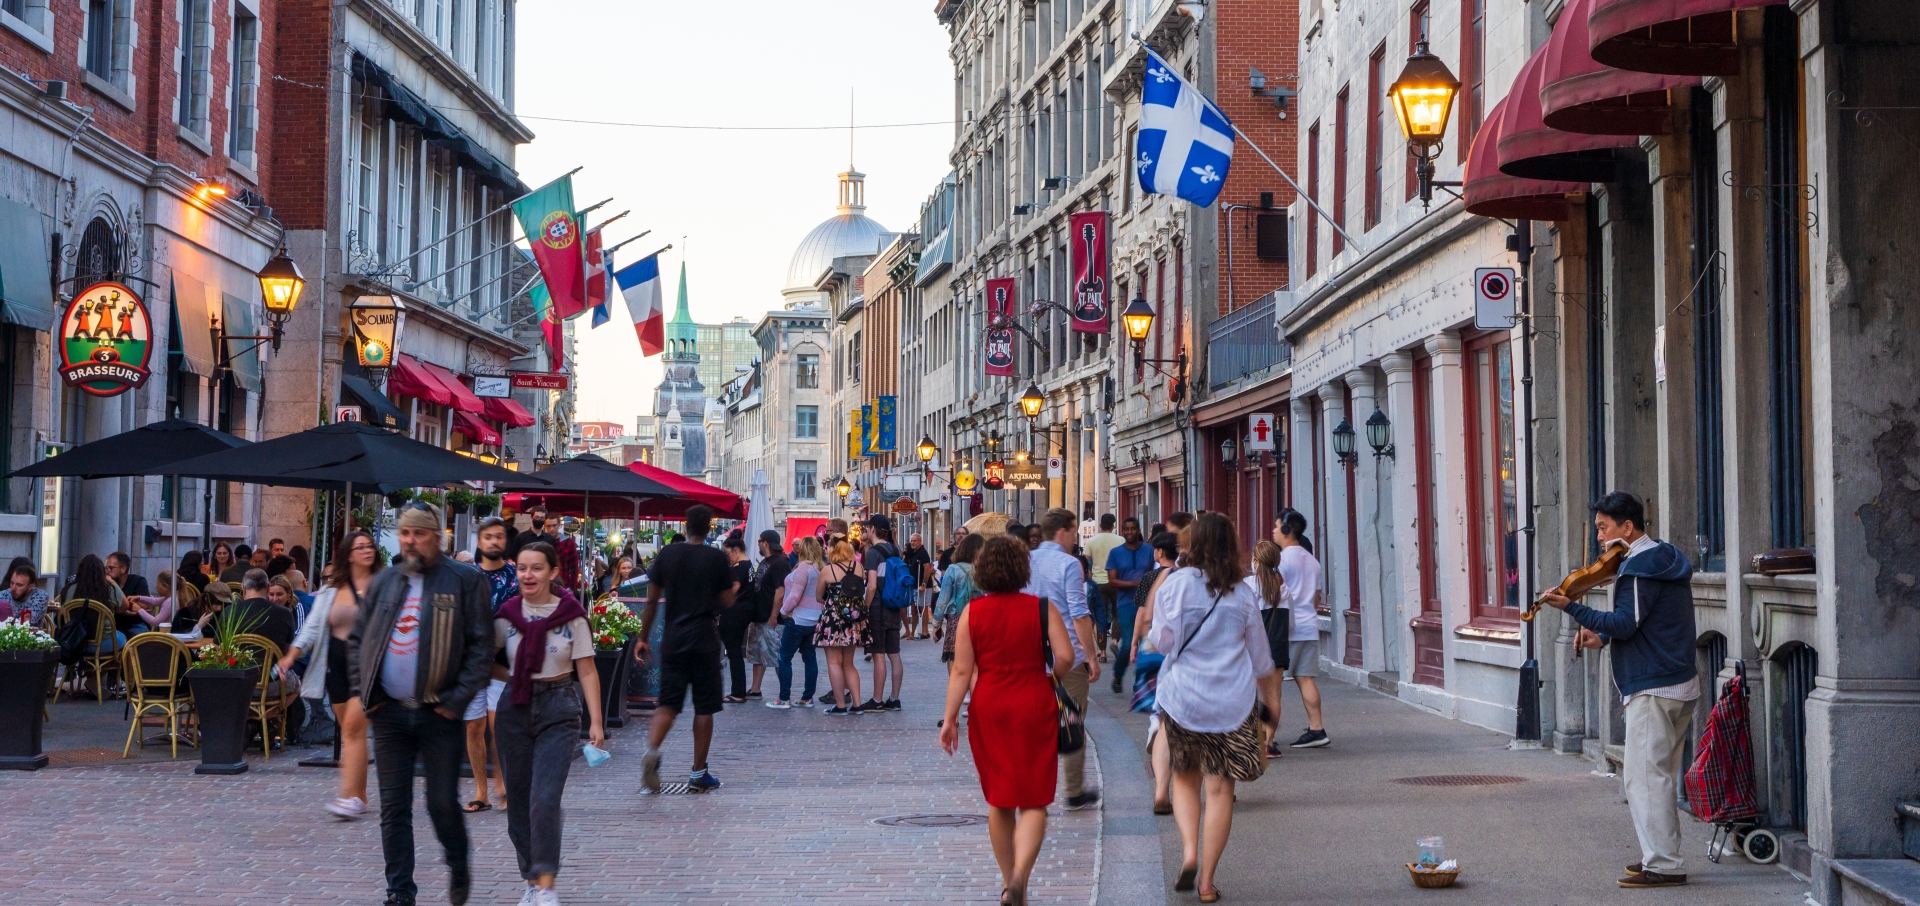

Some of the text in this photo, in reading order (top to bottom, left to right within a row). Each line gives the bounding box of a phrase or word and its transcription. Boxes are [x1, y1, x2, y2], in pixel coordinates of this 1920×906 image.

[1087, 292, 1103, 311] PAUL
[356, 309, 395, 325] SOLMAR
[100, 351, 110, 362] 3
[997, 343, 1011, 359] PAUL
[68, 366, 141, 382] BRASSEURS
[516, 379, 560, 388] Saint-Vincent
[1009, 473, 1042, 481] ARTISANS
